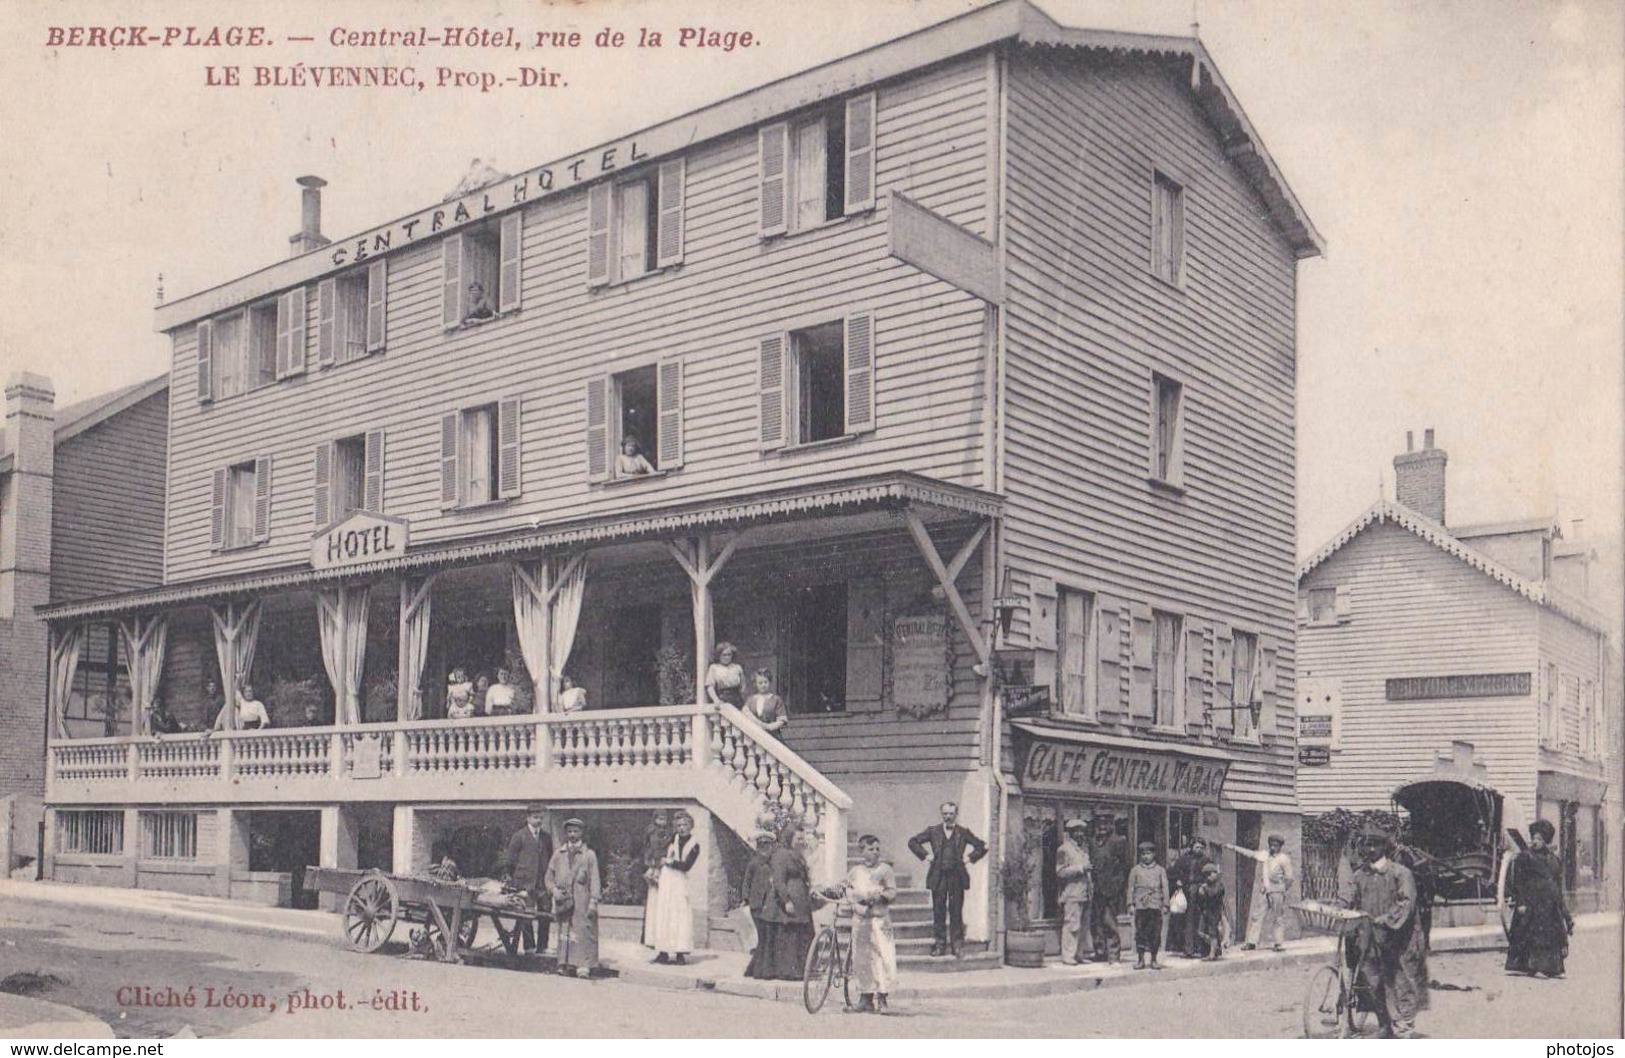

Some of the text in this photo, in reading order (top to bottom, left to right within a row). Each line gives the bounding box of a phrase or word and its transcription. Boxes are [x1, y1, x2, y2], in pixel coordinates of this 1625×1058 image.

[331, 141, 649, 266] CENTRAL HOTEL
[327, 524, 395, 562] HOTEL
[1028, 743, 1224, 796] CAFÉ CENTRAL TABAC
